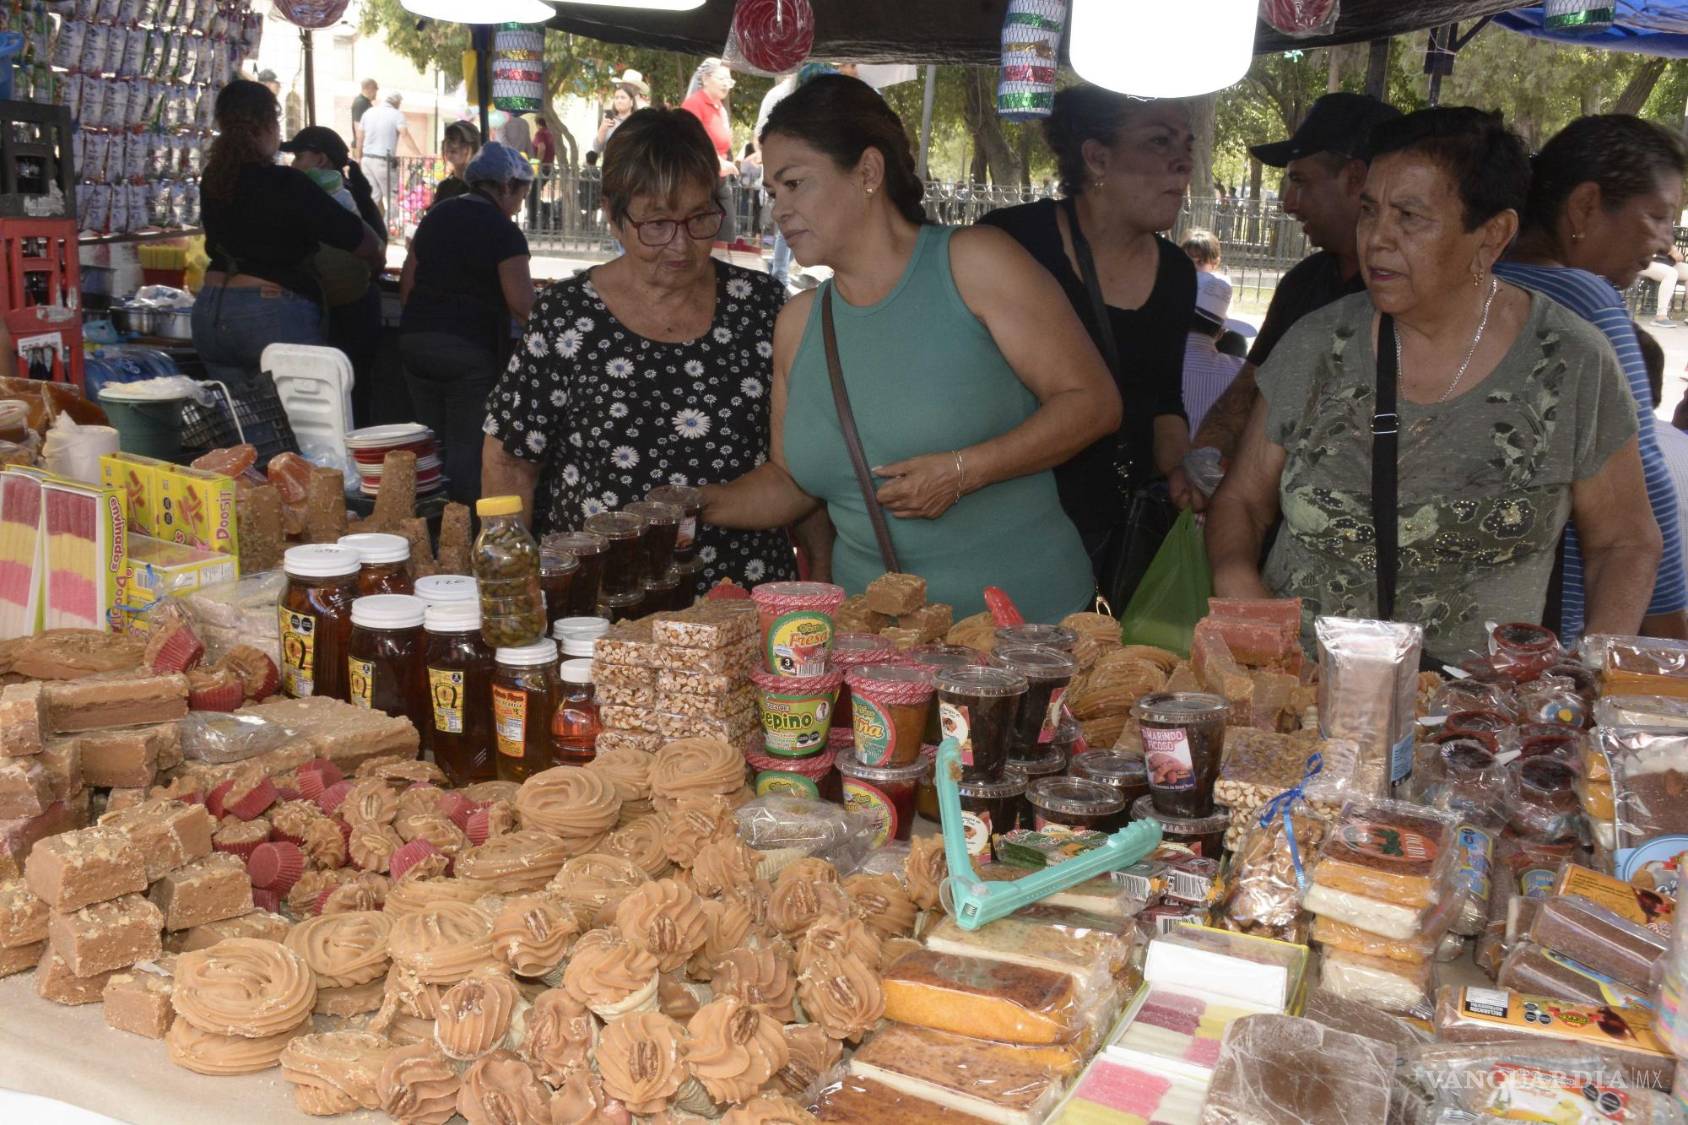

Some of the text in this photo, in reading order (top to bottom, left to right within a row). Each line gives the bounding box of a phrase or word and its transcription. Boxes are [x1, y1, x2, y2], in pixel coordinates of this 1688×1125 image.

[110, 496, 125, 571] envinados
[789, 630, 829, 648] Fresa
[853, 715, 884, 738] iña
